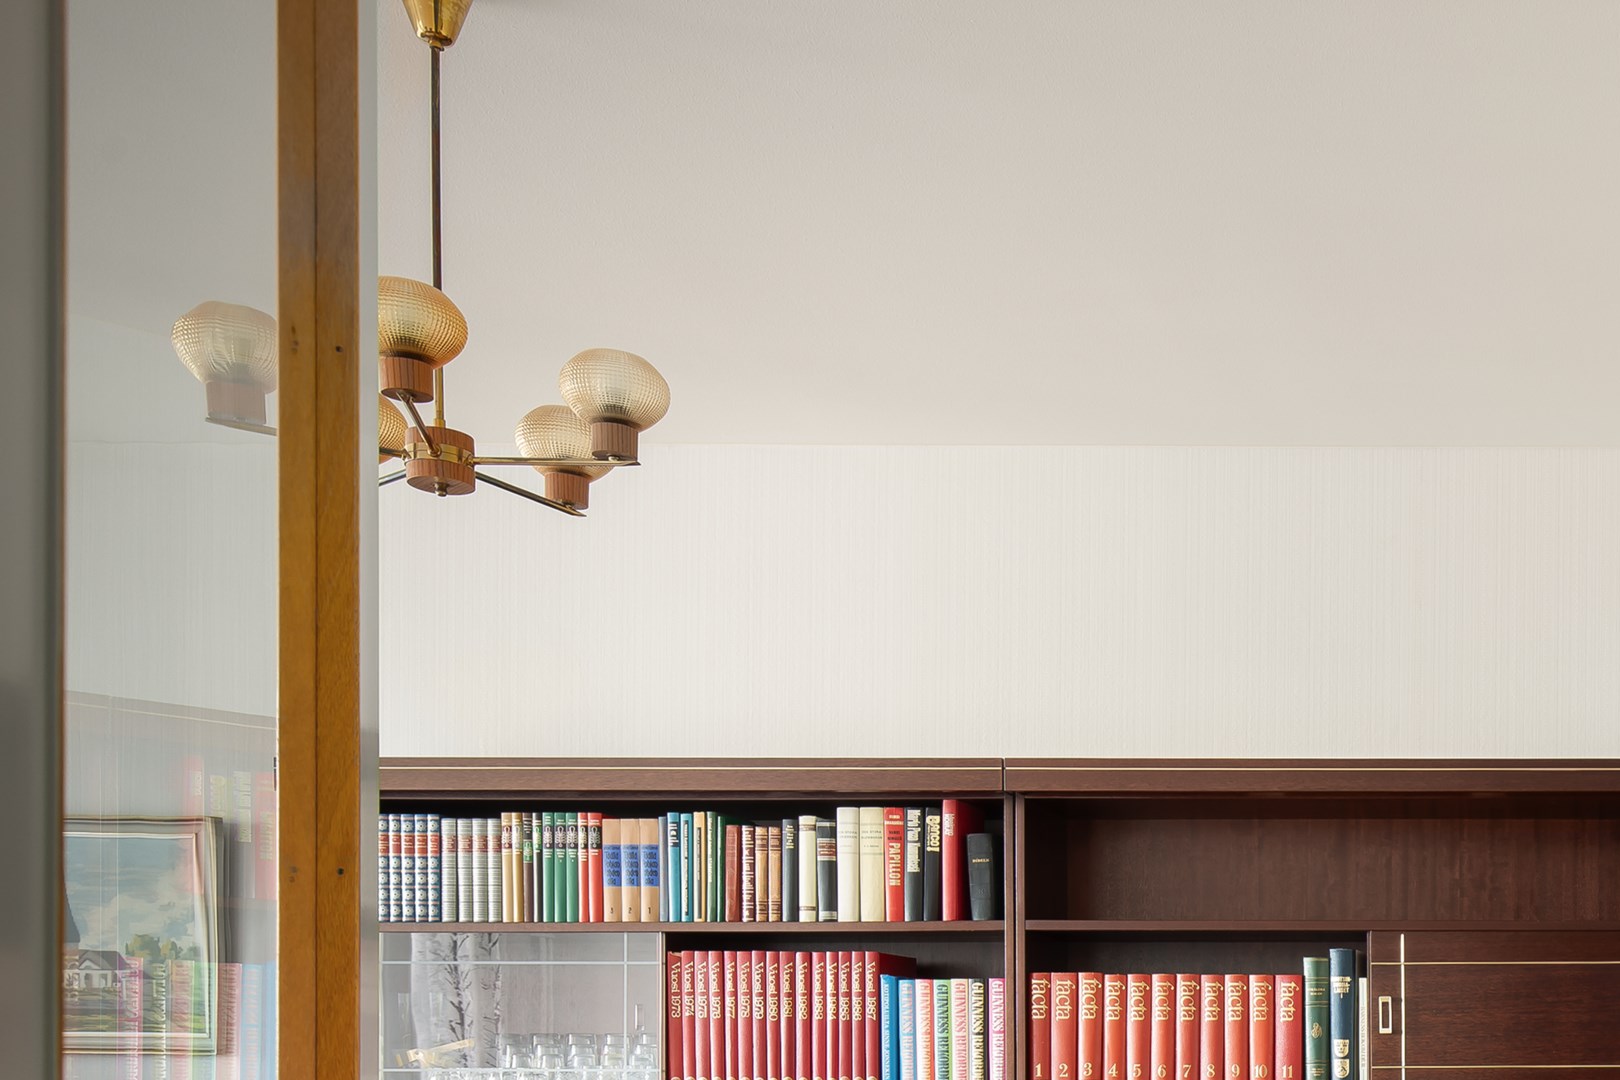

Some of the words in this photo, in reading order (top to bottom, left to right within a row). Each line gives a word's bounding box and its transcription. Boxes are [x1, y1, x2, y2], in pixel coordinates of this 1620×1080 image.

[889, 842, 901, 886] PAPILLON
[671, 962, 681, 993] Vuosi
[684, 961, 694, 993] Vuosi
[697, 962, 707, 993] Vuosi
[711, 961, 720, 993] Vuosi
[726, 962, 735, 992] Vuosi
[741, 962, 750, 993] Vuosi
[754, 962, 764, 993] Vuosi
[768, 963, 778, 994] Vuosi
[783, 962, 793, 993] Vuosi
[799, 962, 808, 993] Vuosi
[815, 962, 824, 993] Vuosi
[828, 962, 837, 994] Vuosi
[840, 962, 850, 992] Vuosi
[853, 962, 862, 992] Vuosi
[867, 961, 876, 992] Vuosi
[671, 995, 681, 1018] 1973
[684, 995, 695, 1017] 1974
[698, 995, 708, 1019] 1975
[726, 996, 736, 1019] 1977
[740, 996, 750, 1018] 1978
[754, 996, 764, 1020] 1979
[768, 997, 778, 1021] 1980
[783, 997, 793, 1018] 1981
[799, 996, 808, 1020] 1982
[815, 996, 824, 1020] 1983
[828, 997, 837, 1020] 1984
[840, 997, 850, 1021] 1985
[853, 997, 862, 1021] 1986
[867, 997, 877, 1021] 1987
[901, 983, 913, 1034] GUINNESS
[920, 982, 931, 1034] GUINNESS
[937, 984, 949, 1034] GUINNESS
[954, 983, 966, 1035] GUINNESS
[972, 982, 984, 1033] GUINNESS
[992, 981, 1004, 1032] GUINNESS
[1031, 978, 1051, 1020] facta
[1055, 978, 1076, 1021] facta
[1082, 978, 1102, 1020] facta
[1105, 980, 1126, 1021] facta
[1130, 981, 1150, 1022] facta
[1155, 980, 1174, 1022] facta
[1180, 980, 1200, 1022] facta
[1204, 981, 1224, 1022] facta
[1227, 981, 1247, 1022] facta
[1253, 981, 1272, 1022] facta
[1280, 981, 1299, 1022] facta
[1035, 1063, 1042, 1077] 1
[1059, 1063, 1069, 1078] 2
[1083, 1062, 1092, 1077] 3
[1108, 1063, 1118, 1077] 4
[1133, 1063, 1142, 1077] 5
[1157, 1064, 1167, 1078] 6
[1182, 1064, 1192, 1078] 7
[1206, 1064, 1216, 1078] 8
[1231, 1064, 1240, 1078] 9
[1254, 1064, 1268, 1078] 10
[1281, 1064, 1293, 1079] 11
